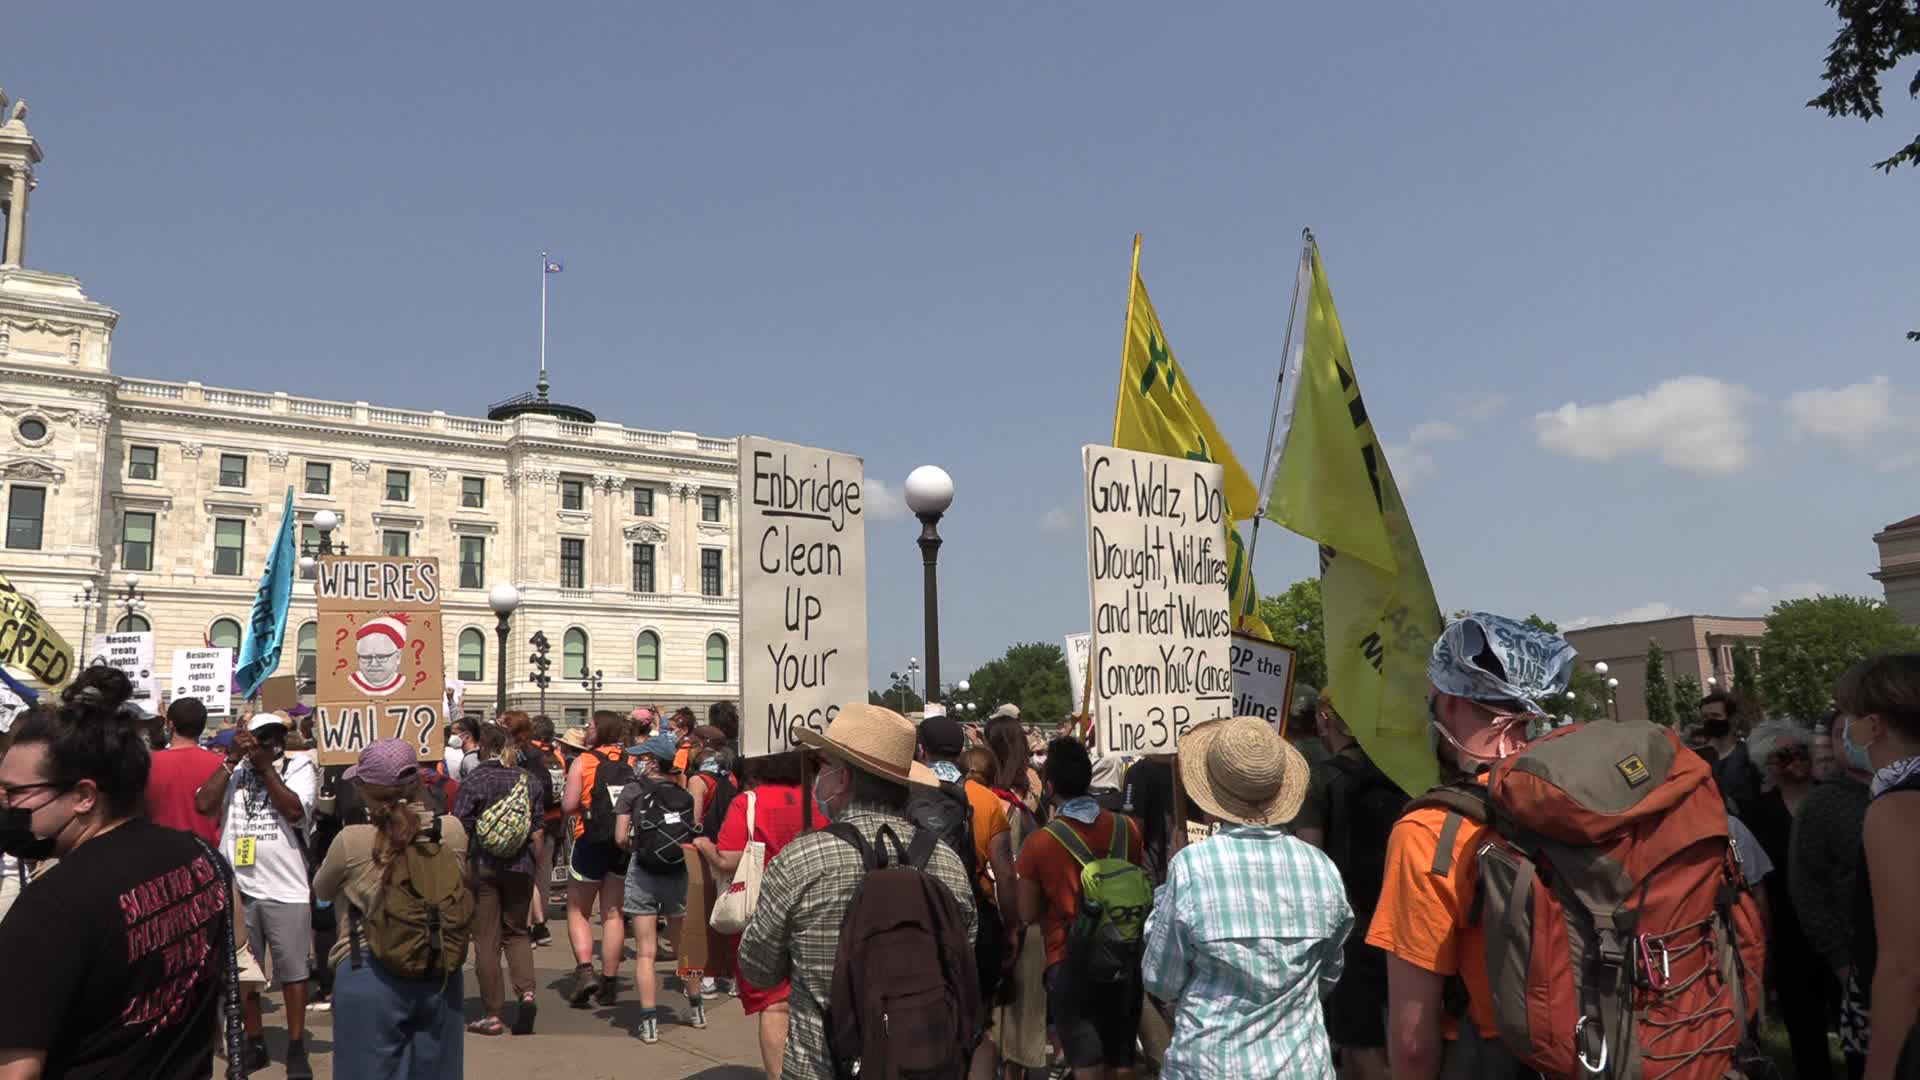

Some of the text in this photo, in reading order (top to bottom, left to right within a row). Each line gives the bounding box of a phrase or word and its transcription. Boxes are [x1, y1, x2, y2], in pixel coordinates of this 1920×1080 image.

[753, 451, 862, 532] Enbridge
[1091, 456, 1222, 527] Gov. Walz, Do
[760, 525, 842, 576] Clean
[1093, 525, 1229, 591] Drought, Wildfires,
[319, 559, 437, 603] WHERE'S
[3, 597, 42, 628] THE
[785, 585, 822, 641] Up
[1097, 589, 1230, 639] and Heat Waves
[106, 635, 141, 644] Respect
[111, 646, 137, 656] treaty
[186, 651, 220, 660] Respect
[188, 672, 216, 682] rights!
[190, 662, 214, 670] treaty
[767, 643, 838, 695] Your
[1099, 644, 1233, 700] Concern You? Cancel
[1230, 645, 1282, 677] OP the
[191, 684, 211, 693] Stop
[1232, 692, 1278, 723] eline
[1108, 705, 1146, 752] Line
[1147, 706, 1169, 748] 3
[241, 838, 251, 864] PRESS
